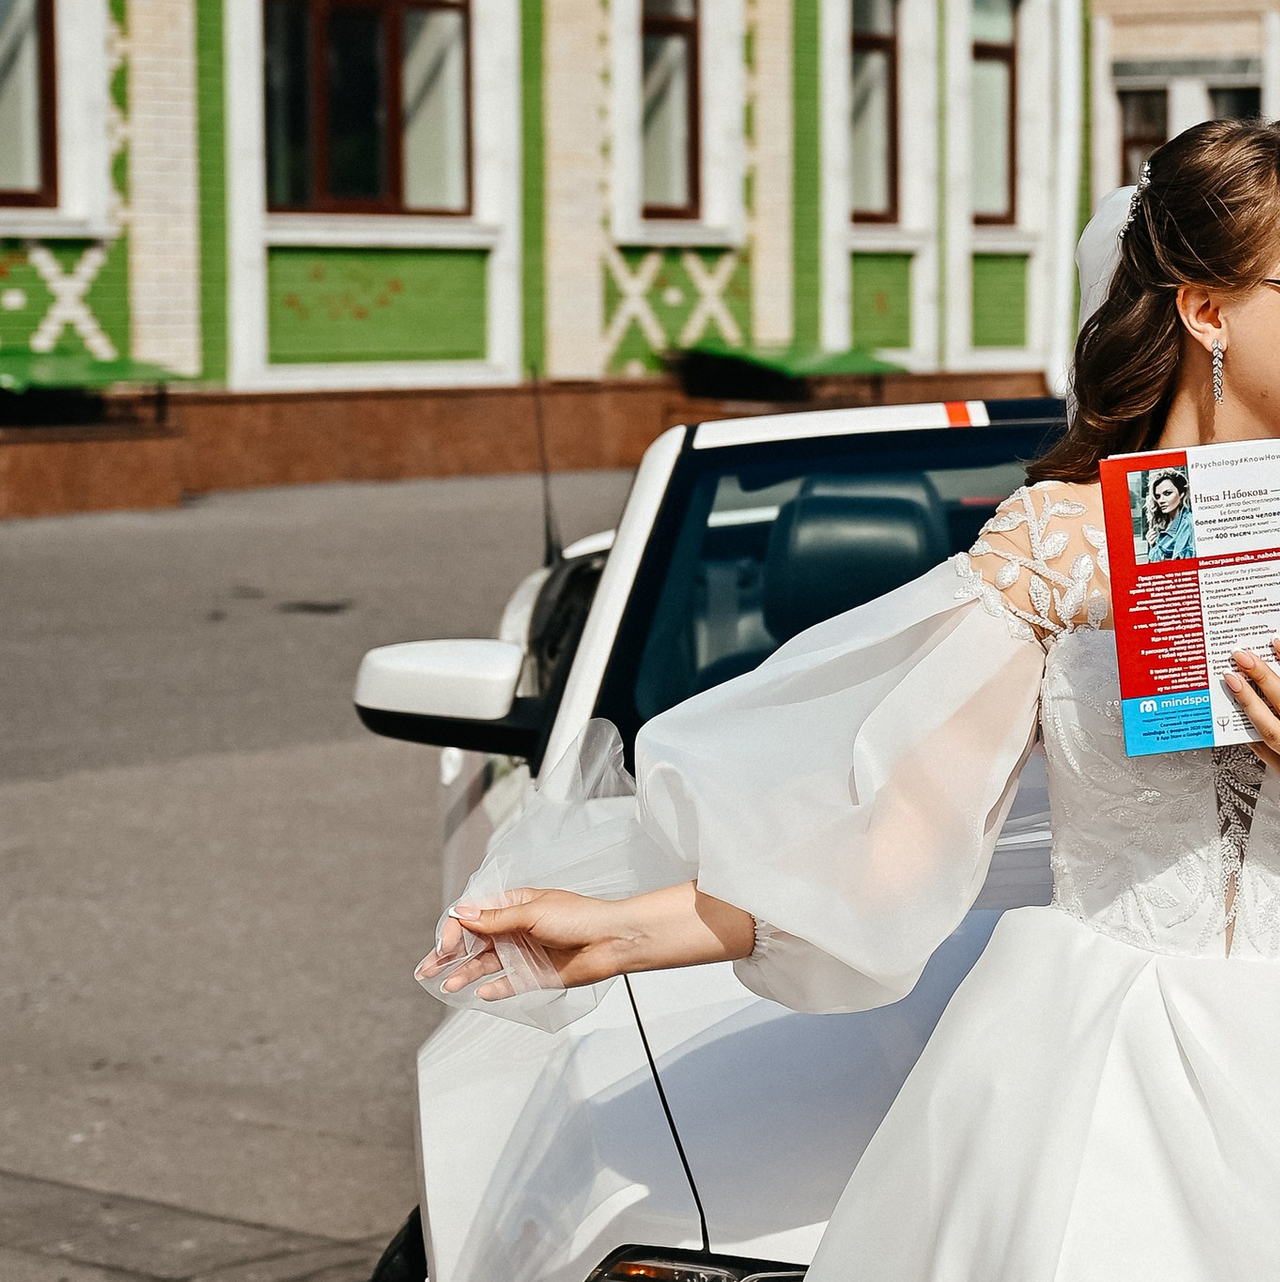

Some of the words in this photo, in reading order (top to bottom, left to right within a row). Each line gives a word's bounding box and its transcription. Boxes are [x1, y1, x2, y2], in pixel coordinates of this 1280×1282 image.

[1194, 493, 1220, 503] Ника
[1222, 489, 1268, 500] Набокова
[1218, 514, 1254, 523] миллиона
[1161, 695, 1209, 708] mindspa
